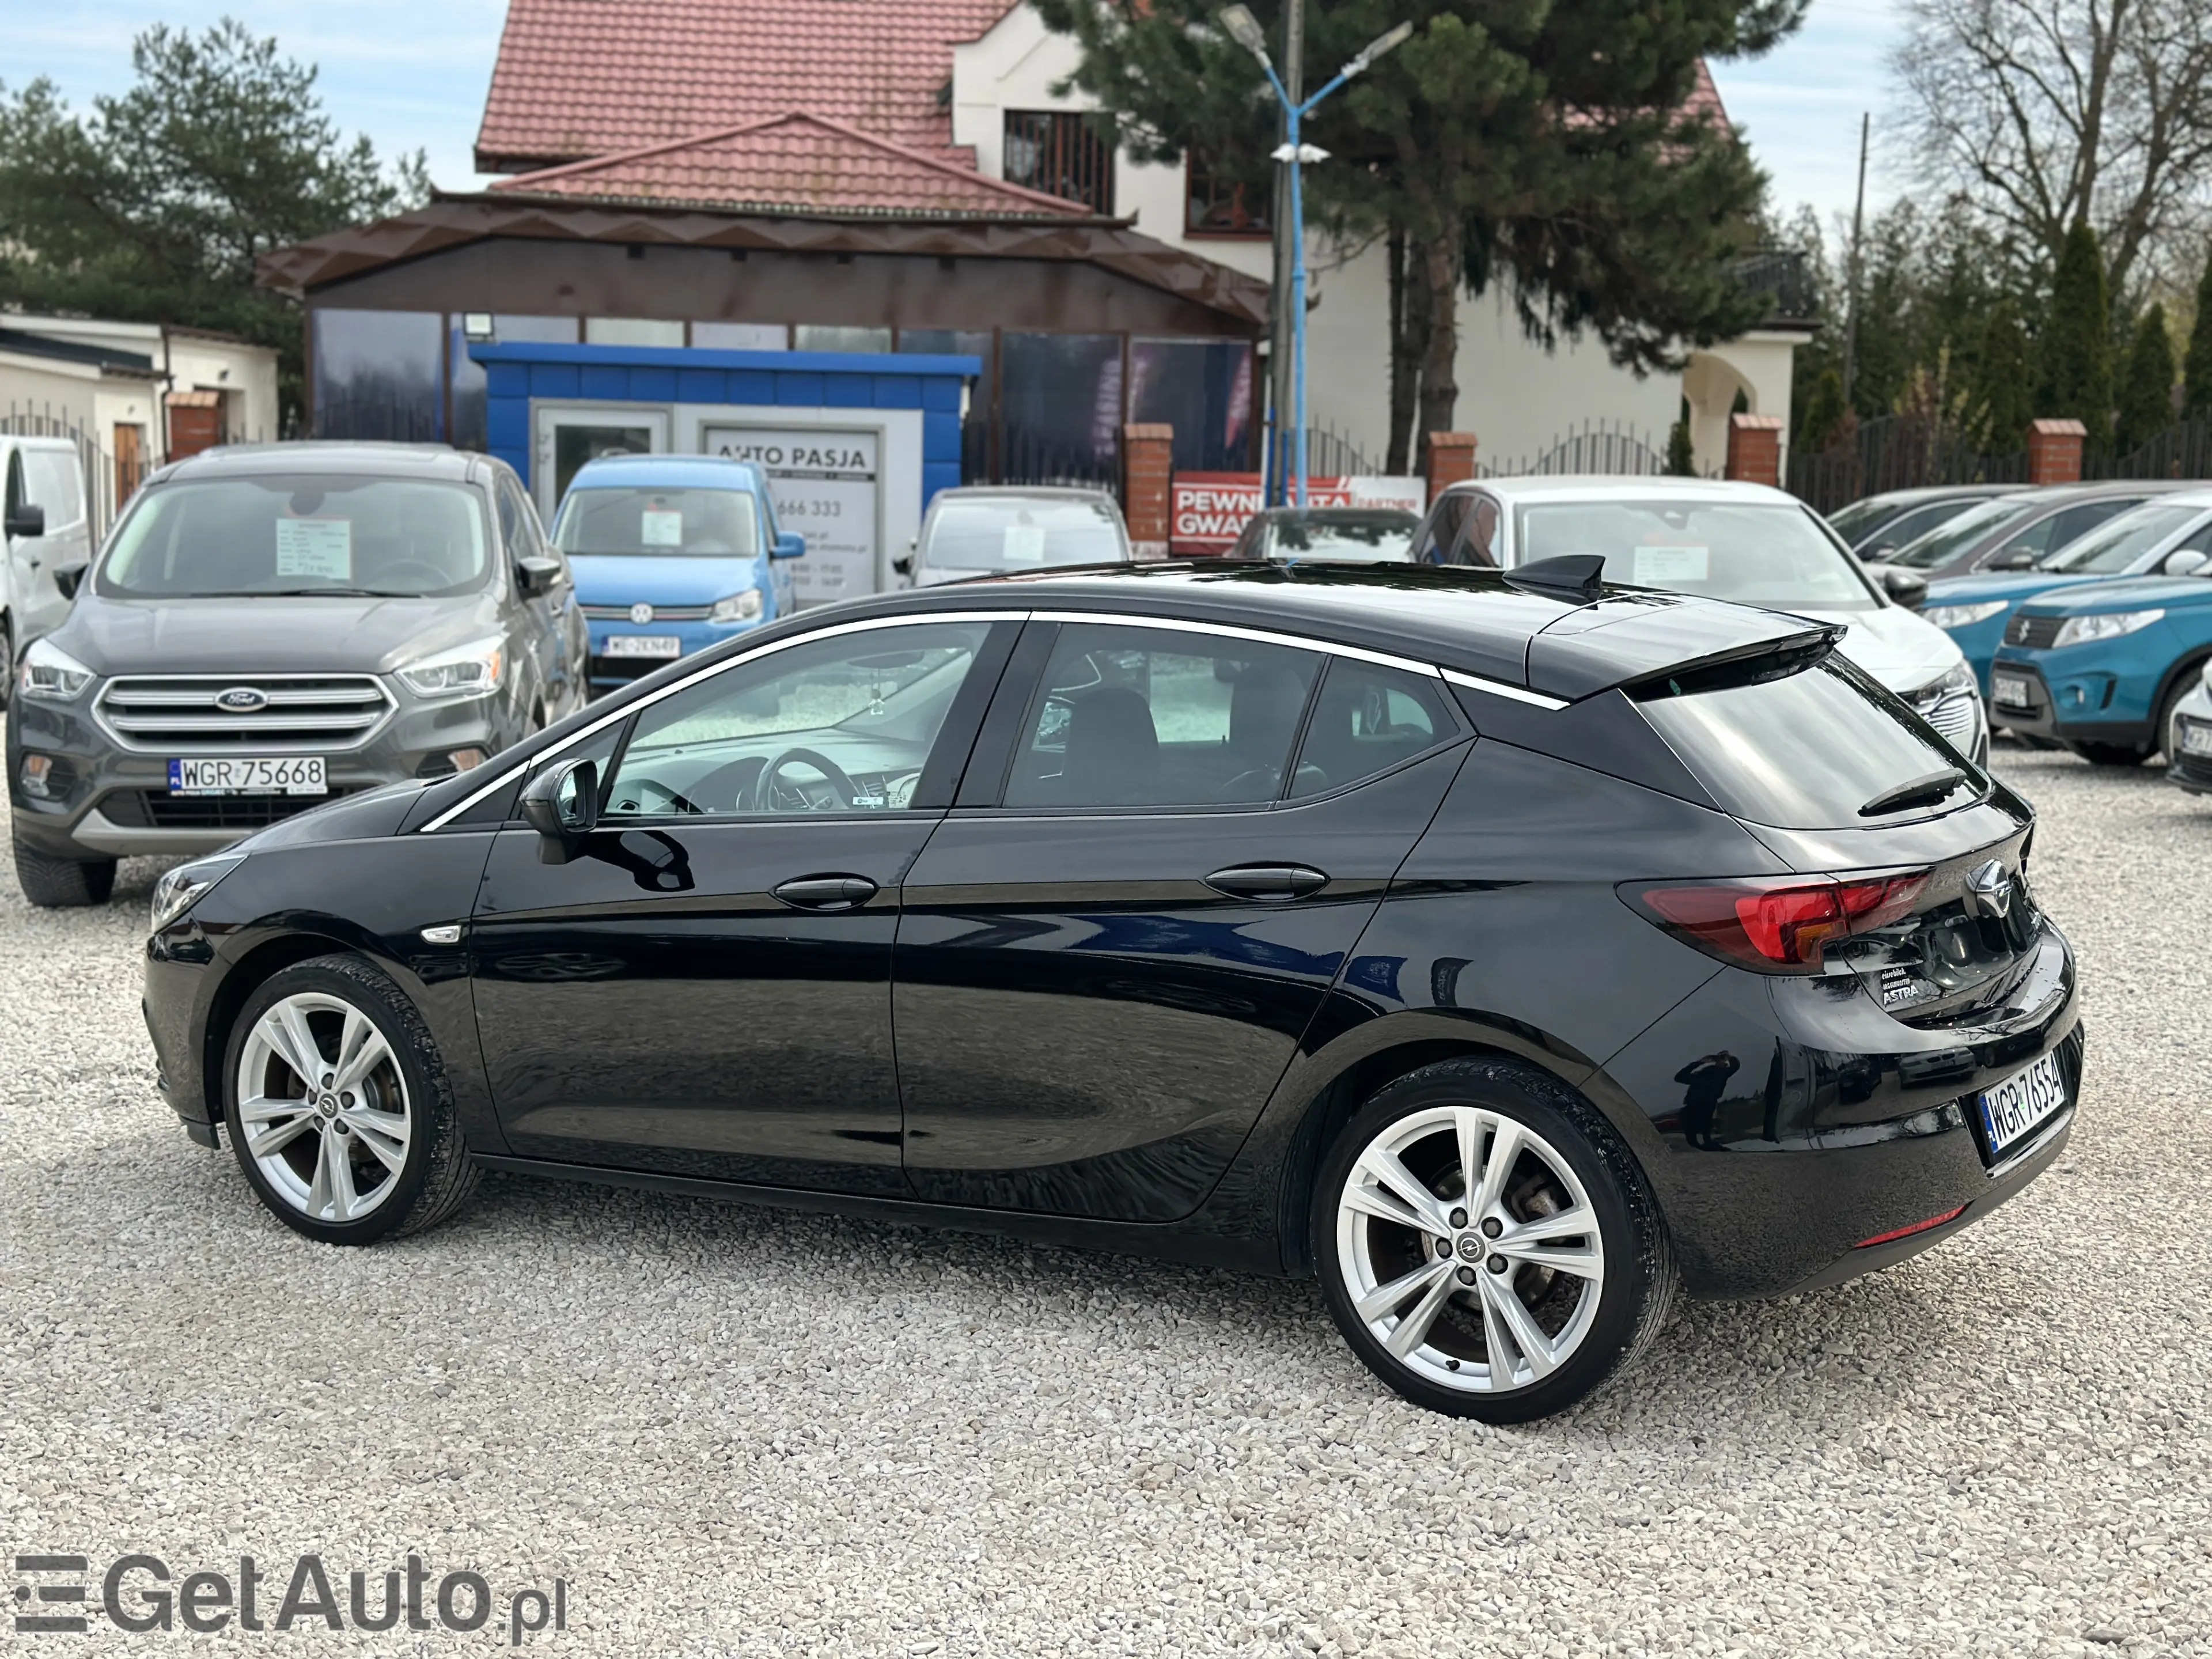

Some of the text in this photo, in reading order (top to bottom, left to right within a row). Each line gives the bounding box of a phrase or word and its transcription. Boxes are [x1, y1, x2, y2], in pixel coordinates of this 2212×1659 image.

[792, 448, 866, 468] PASJA
[778, 500, 841, 517] 666 333
[1177, 490, 1265, 513] PEWN
[183, 760, 322, 786] WGR 75668
[1884, 984, 1919, 1005] ASTRA
[1988, 1053, 2063, 1142] WGR 76554
